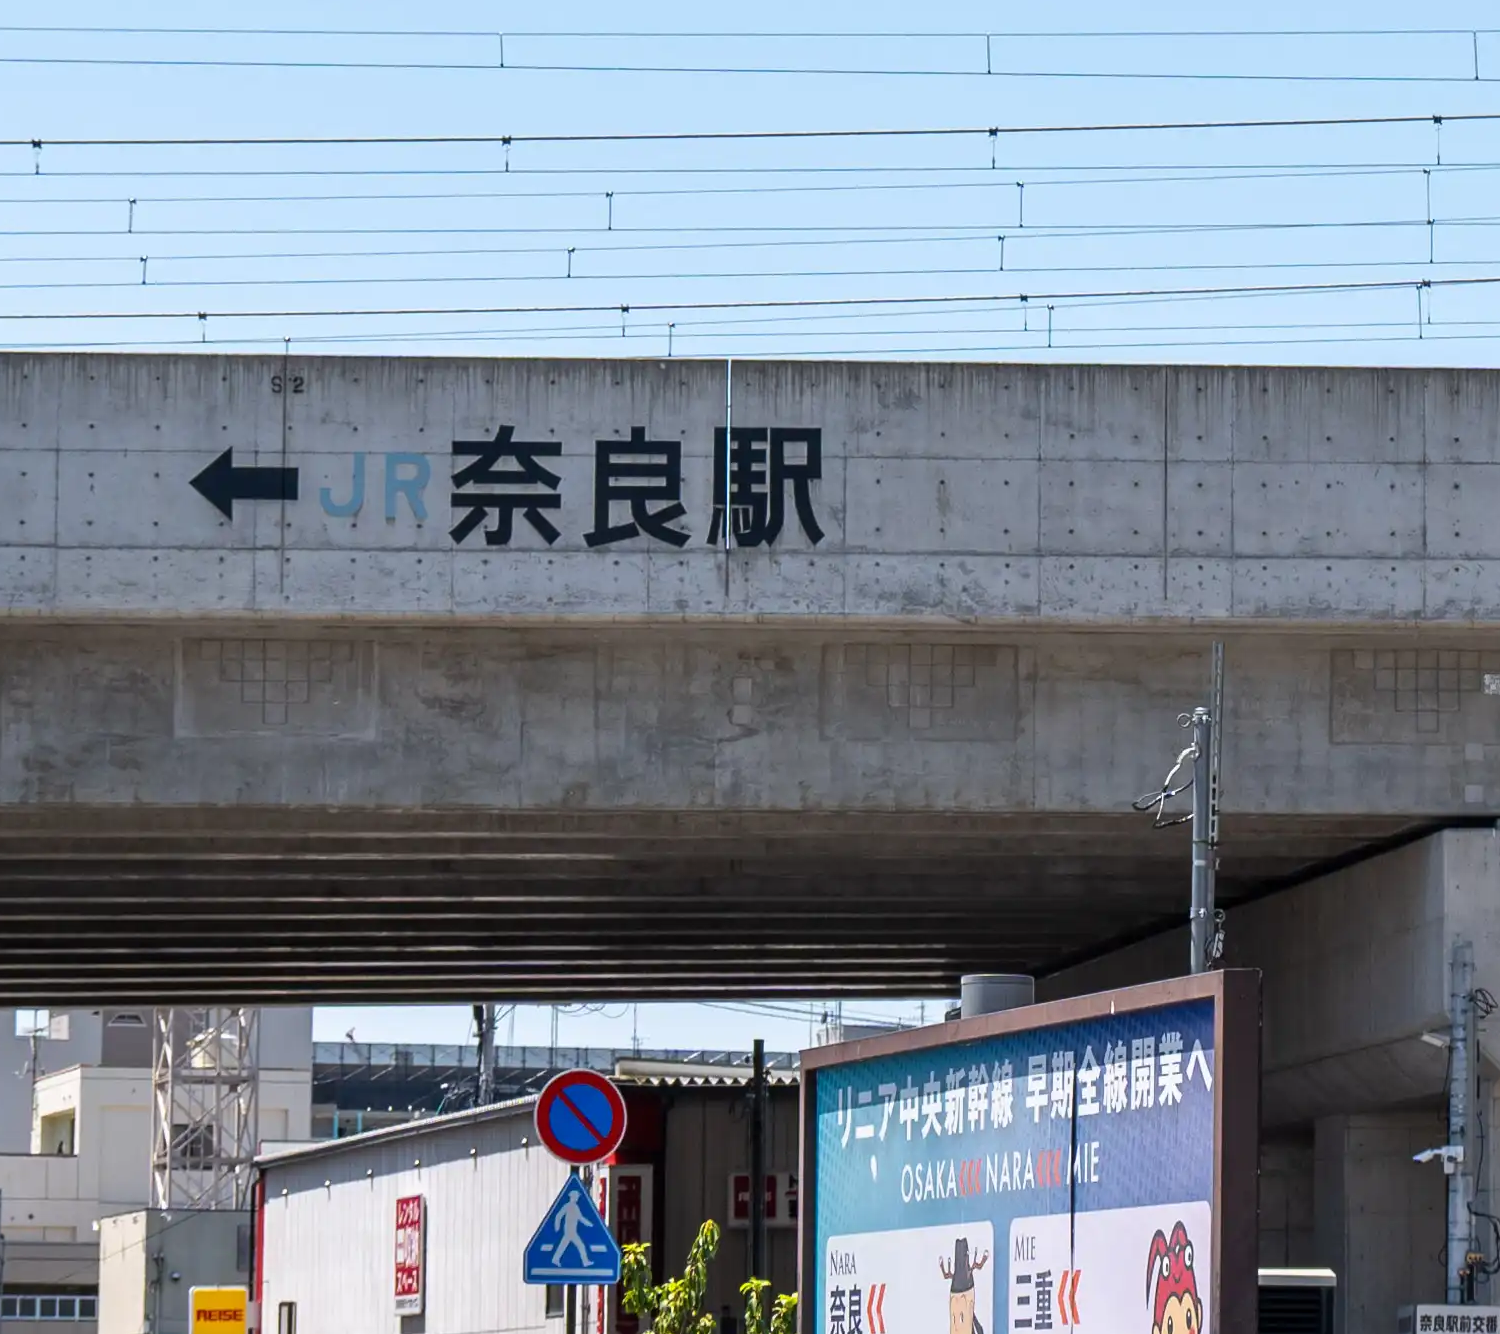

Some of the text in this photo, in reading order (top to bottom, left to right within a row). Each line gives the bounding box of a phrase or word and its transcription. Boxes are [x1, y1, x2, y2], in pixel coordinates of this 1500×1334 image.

[836, 1031, 1214, 1150] リニア中央新幹線 早期全線開業へ
[901, 1157, 958, 1203] OSAKA
[985, 1147, 1035, 1194] NARA
[829, 1249, 858, 1277] NARA
[1014, 1235, 1037, 1262] MIE
[1014, 1269, 1054, 1331] 三重
[1419, 1313, 1499, 1334] 奈良駅前交番
